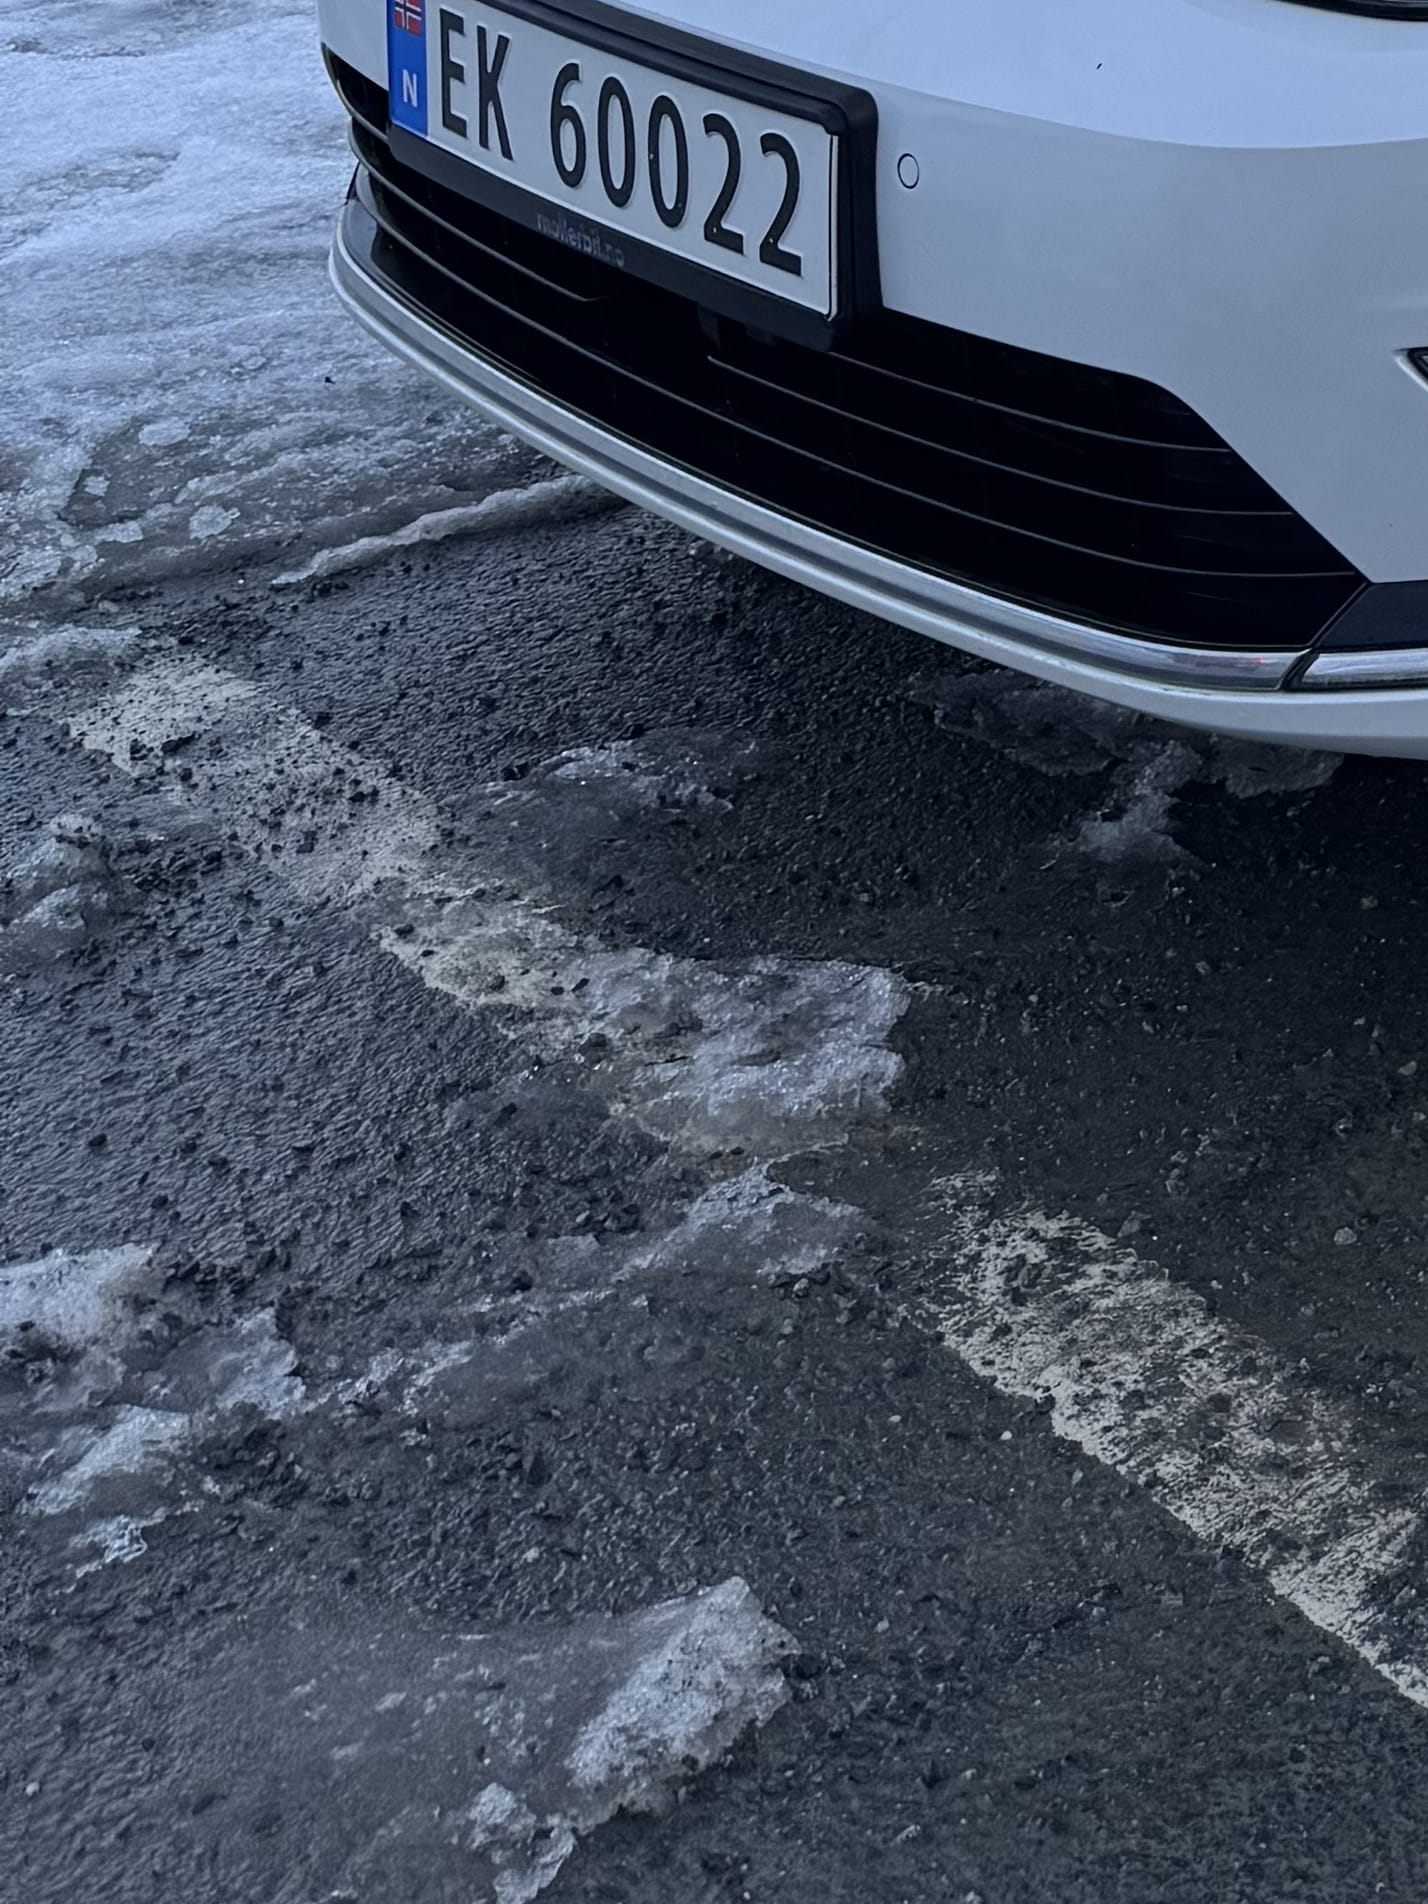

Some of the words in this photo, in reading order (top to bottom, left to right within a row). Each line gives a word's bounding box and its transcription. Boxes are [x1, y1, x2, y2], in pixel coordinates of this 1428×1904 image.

[402, 68, 419, 109] N
[439, 7, 514, 162] EK
[550, 62, 803, 278] 60022
